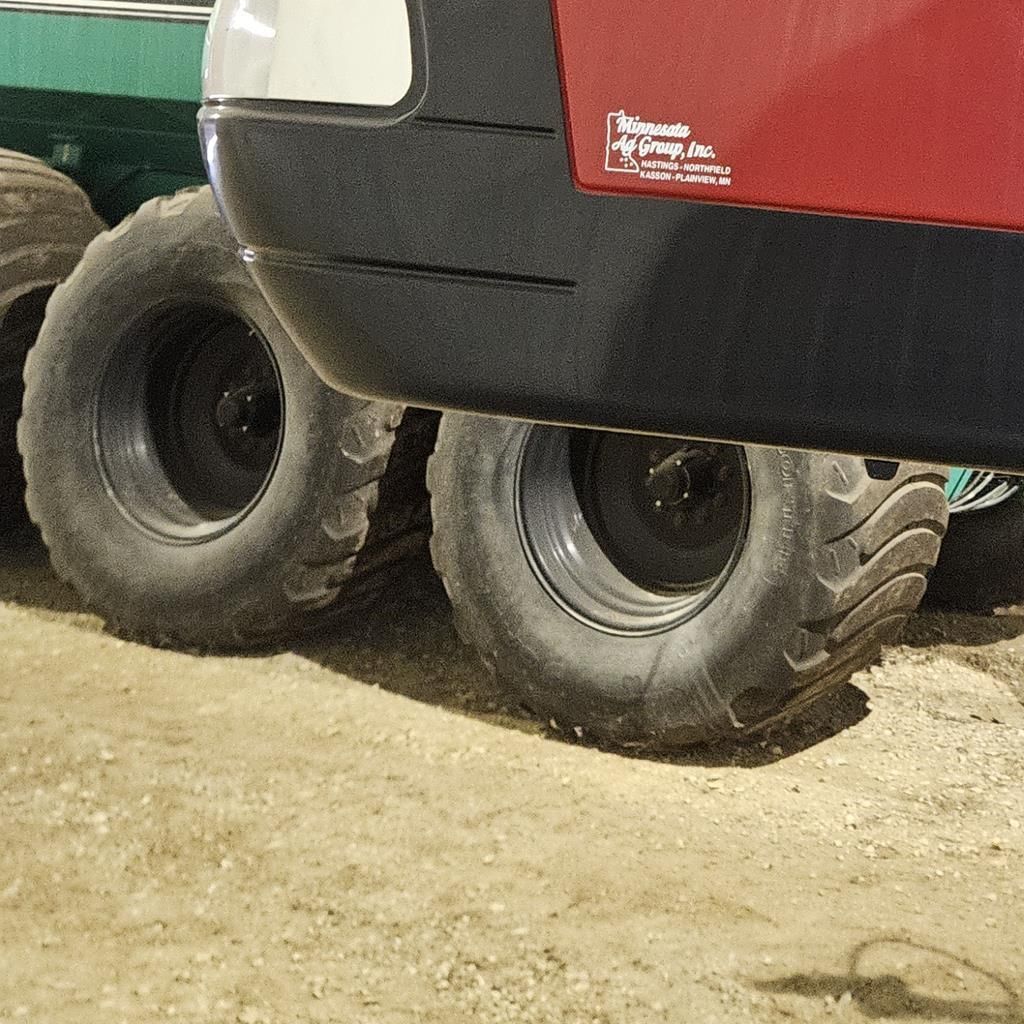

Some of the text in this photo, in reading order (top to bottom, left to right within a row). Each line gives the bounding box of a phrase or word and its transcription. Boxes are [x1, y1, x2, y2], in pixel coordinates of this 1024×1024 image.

[616, 115, 691, 139] Minnesota
[611, 134, 716, 160] Ag Group, Inc.
[641, 160, 679, 170] HASTINGS
[683, 163, 731, 175] NORTHFIELD
[640, 171, 671, 181] KASSON
[675, 173, 718, 186] PLAINVIEW,
[719, 177, 731, 186] MN
